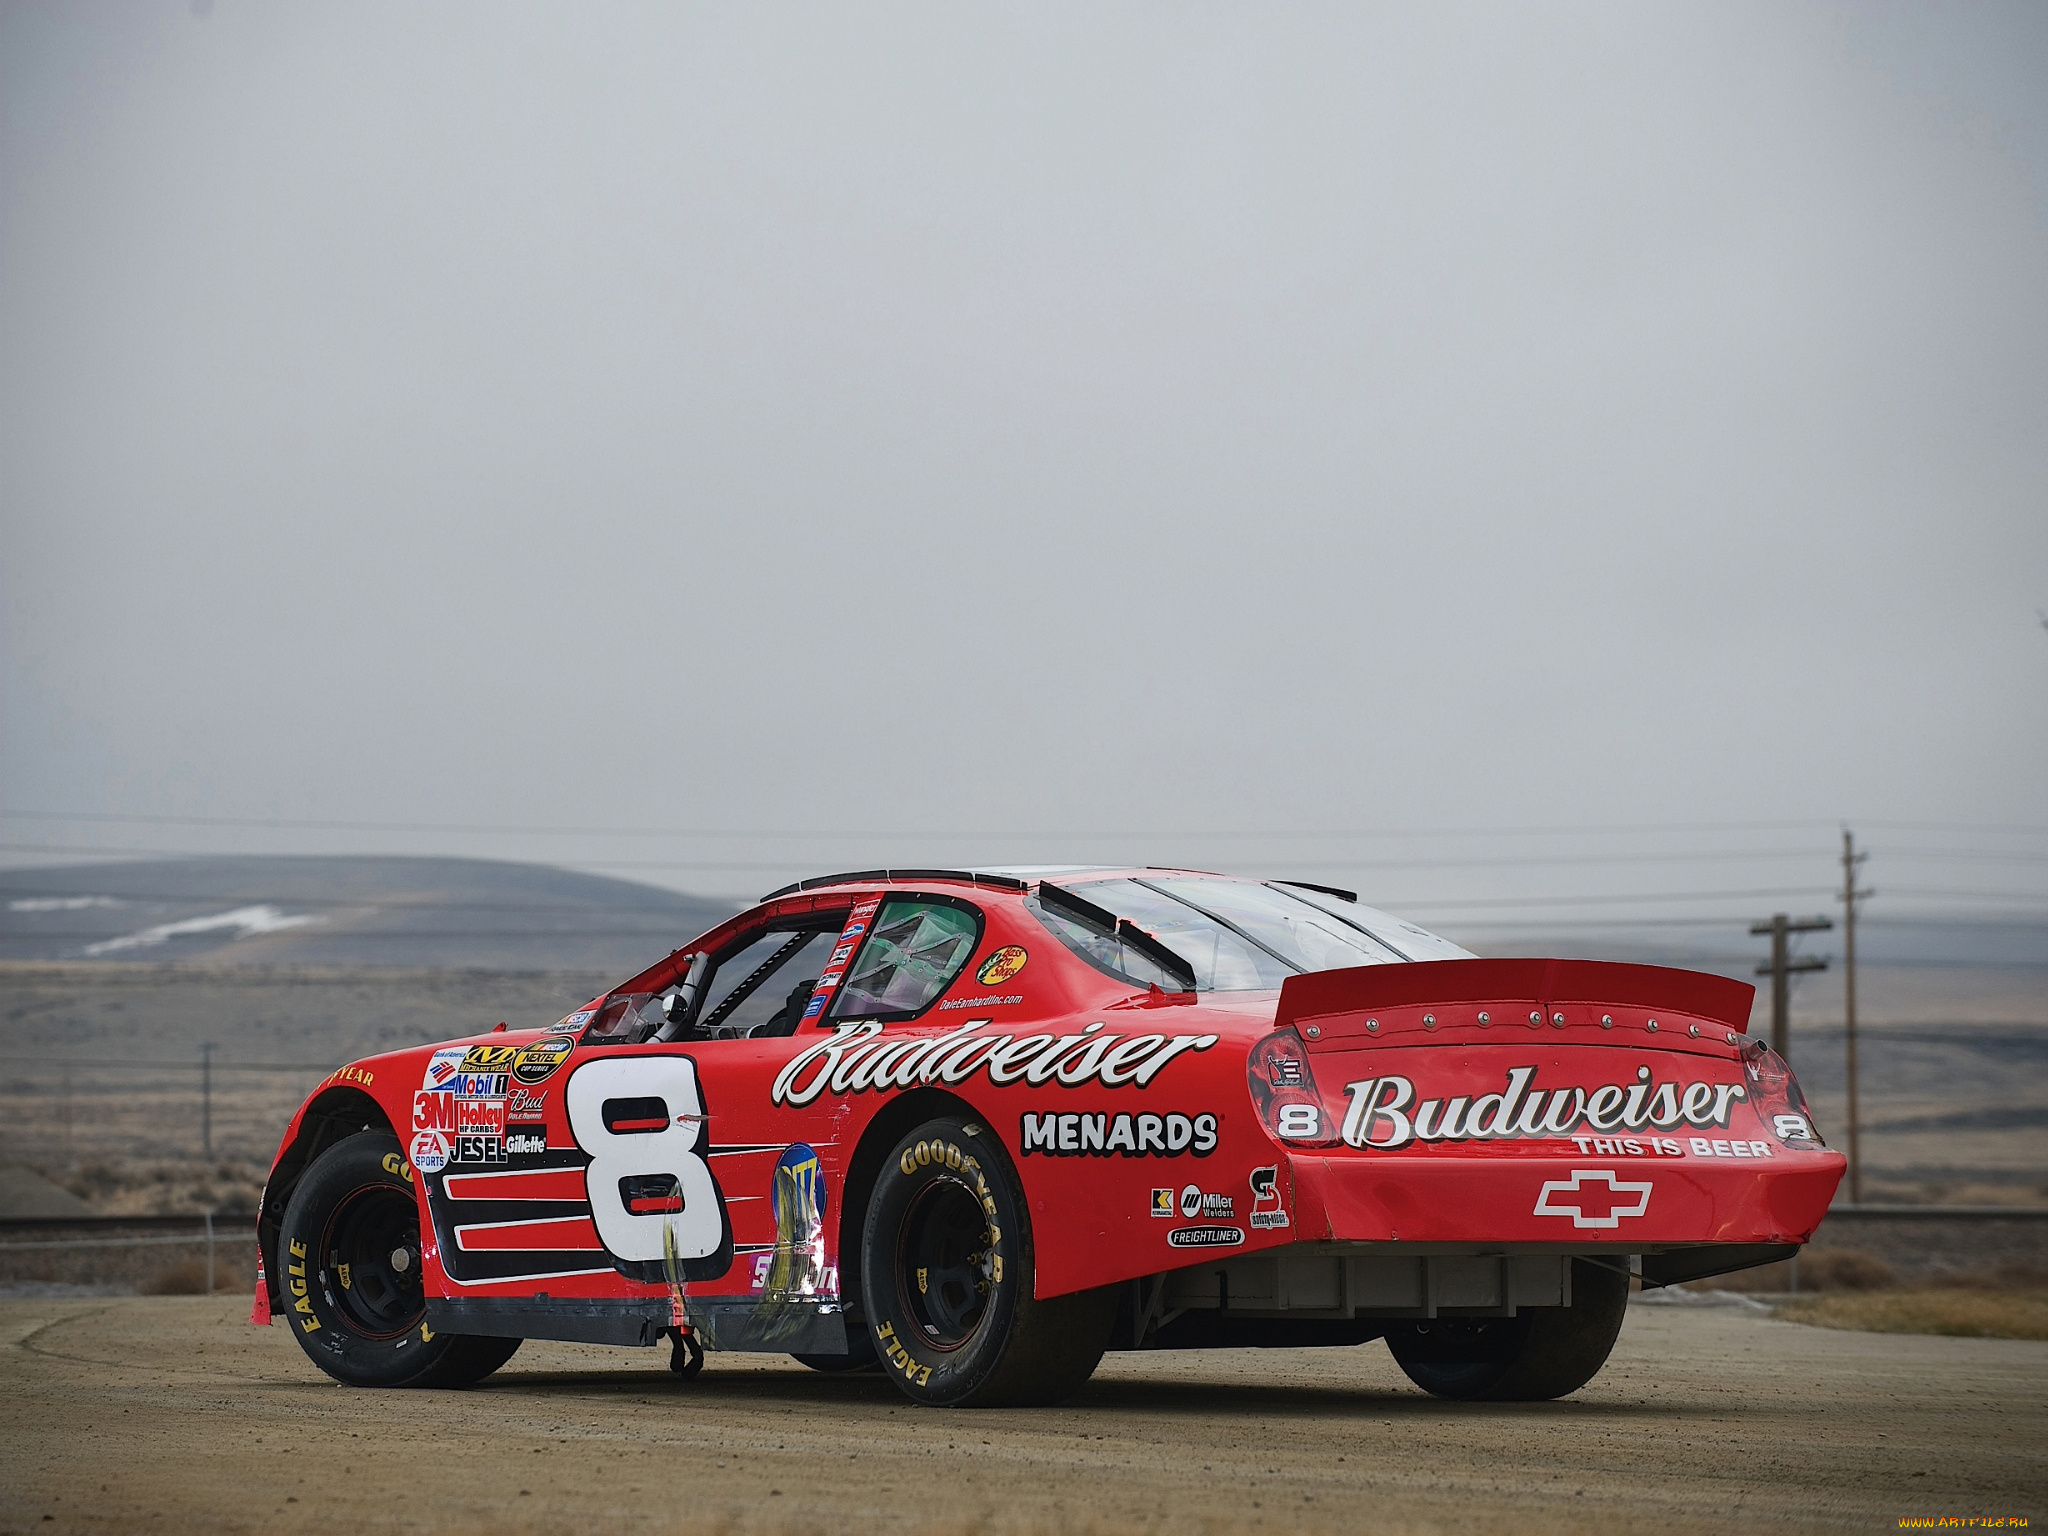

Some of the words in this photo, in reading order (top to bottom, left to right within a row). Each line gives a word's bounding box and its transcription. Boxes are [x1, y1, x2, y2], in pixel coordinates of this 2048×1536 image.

[522, 1053, 557, 1062] NEXTEL
[773, 1019, 1219, 1106] Budweiser
[454, 1074, 494, 1094] Mobil
[414, 1092, 453, 1129] 3M
[508, 1088, 548, 1111] Bud
[1340, 1065, 1746, 1150] Budweiser
[460, 1103, 503, 1131] Holley
[1278, 1104, 1318, 1137] 8
[1773, 1115, 1811, 1139] 8
[470, 1125, 494, 1133] CARBS
[1023, 1112, 1219, 1152] MENARDS
[450, 1136, 506, 1162] JESEL
[506, 1134, 545, 1153] Gillette
[1571, 1136, 1648, 1157] THIS
[1653, 1136, 1682, 1157] IS
[1694, 1139, 1773, 1159] BEER
[415, 1155, 444, 1166] SPORTS
[566, 1054, 722, 1262] 8
[1203, 1194, 1232, 1208] Miller
[1203, 1208, 1234, 1217] Welders
[1173, 1230, 1238, 1243] FREIGHTLINER
[289, 1237, 322, 1333] EAGLE
[340, 1266, 349, 1285] AERO
[875, 1320, 932, 1387] EAGLE
